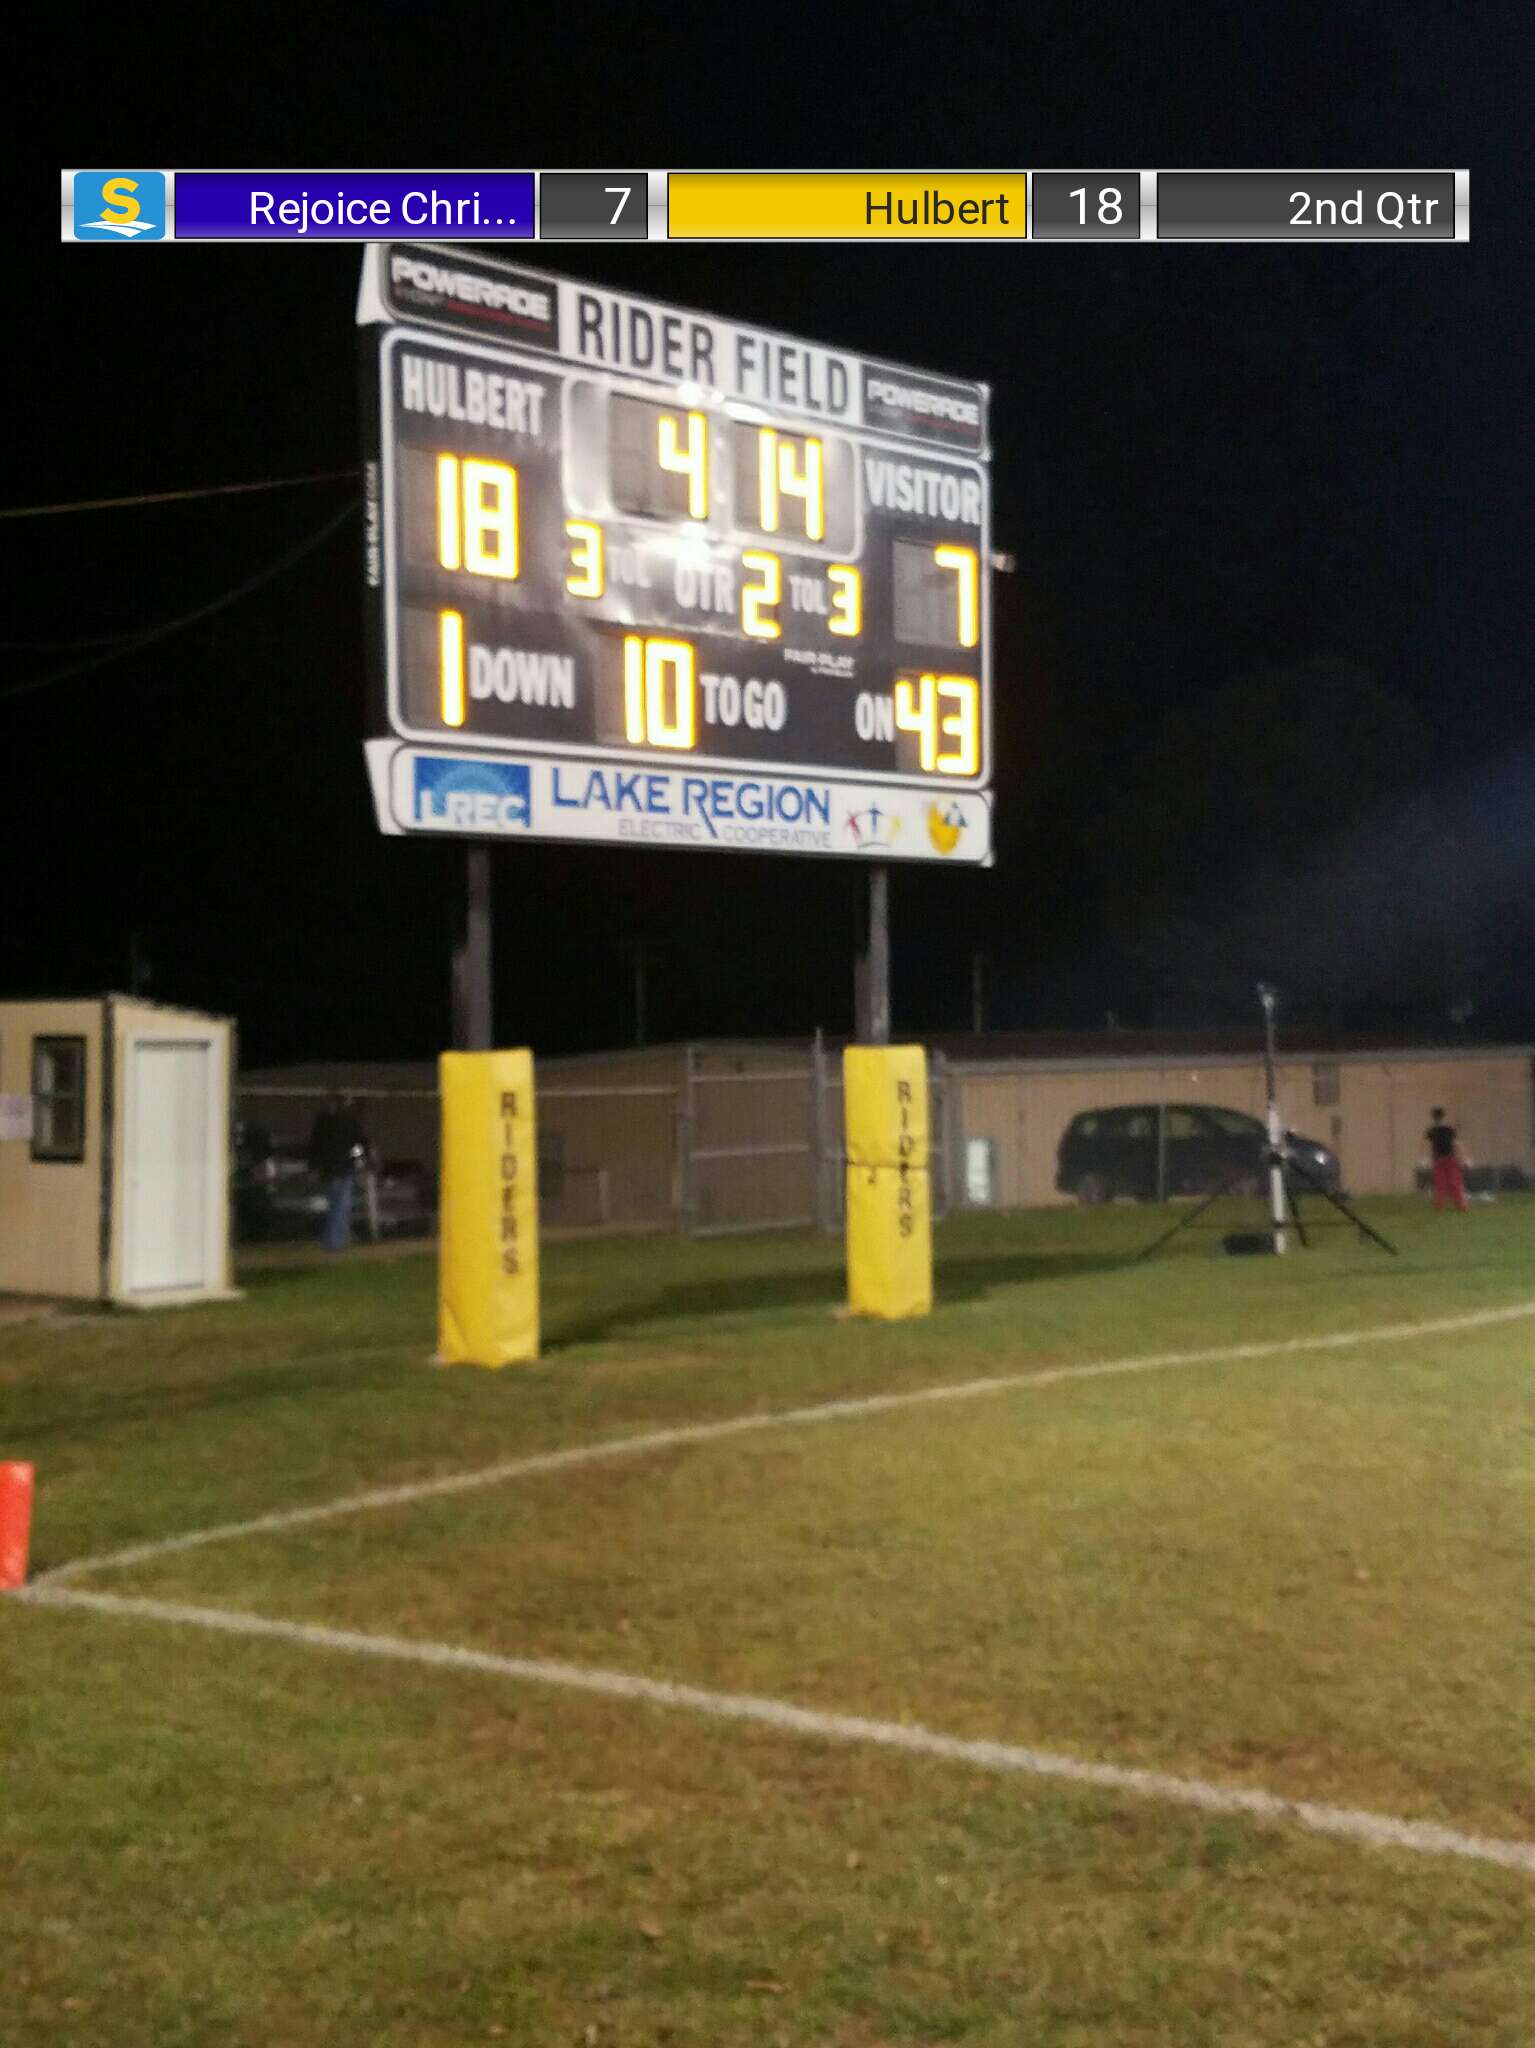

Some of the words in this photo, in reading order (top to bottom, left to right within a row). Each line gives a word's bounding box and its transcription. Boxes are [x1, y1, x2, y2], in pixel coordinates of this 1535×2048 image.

[401, 353, 544, 436] HULBERT
[577, 294, 715, 388] RIDER
[735, 334, 849, 414] FIELD
[437, 452, 520, 580] 18
[658, 409, 708, 520] 4
[758, 426, 825, 542] 14
[865, 458, 981, 526] VISITOR
[564, 518, 604, 598] 3
[741, 550, 782, 639] 2
[933, 542, 979, 649] 7
[827, 563, 862, 637] 3
[440, 606, 466, 728] 1
[467, 643, 575, 710] DOWN
[623, 634, 695, 750] 10
[699, 673, 741, 727] TO
[742, 677, 787, 732] GO
[854, 692, 895, 743] ON
[894, 672, 979, 776] 43
[551, 766, 671, 815] LAKE
[682, 777, 830, 839] REGION
[617, 818, 701, 841] ELECTRIC
[722, 824, 831, 849] COOPERATIVE
